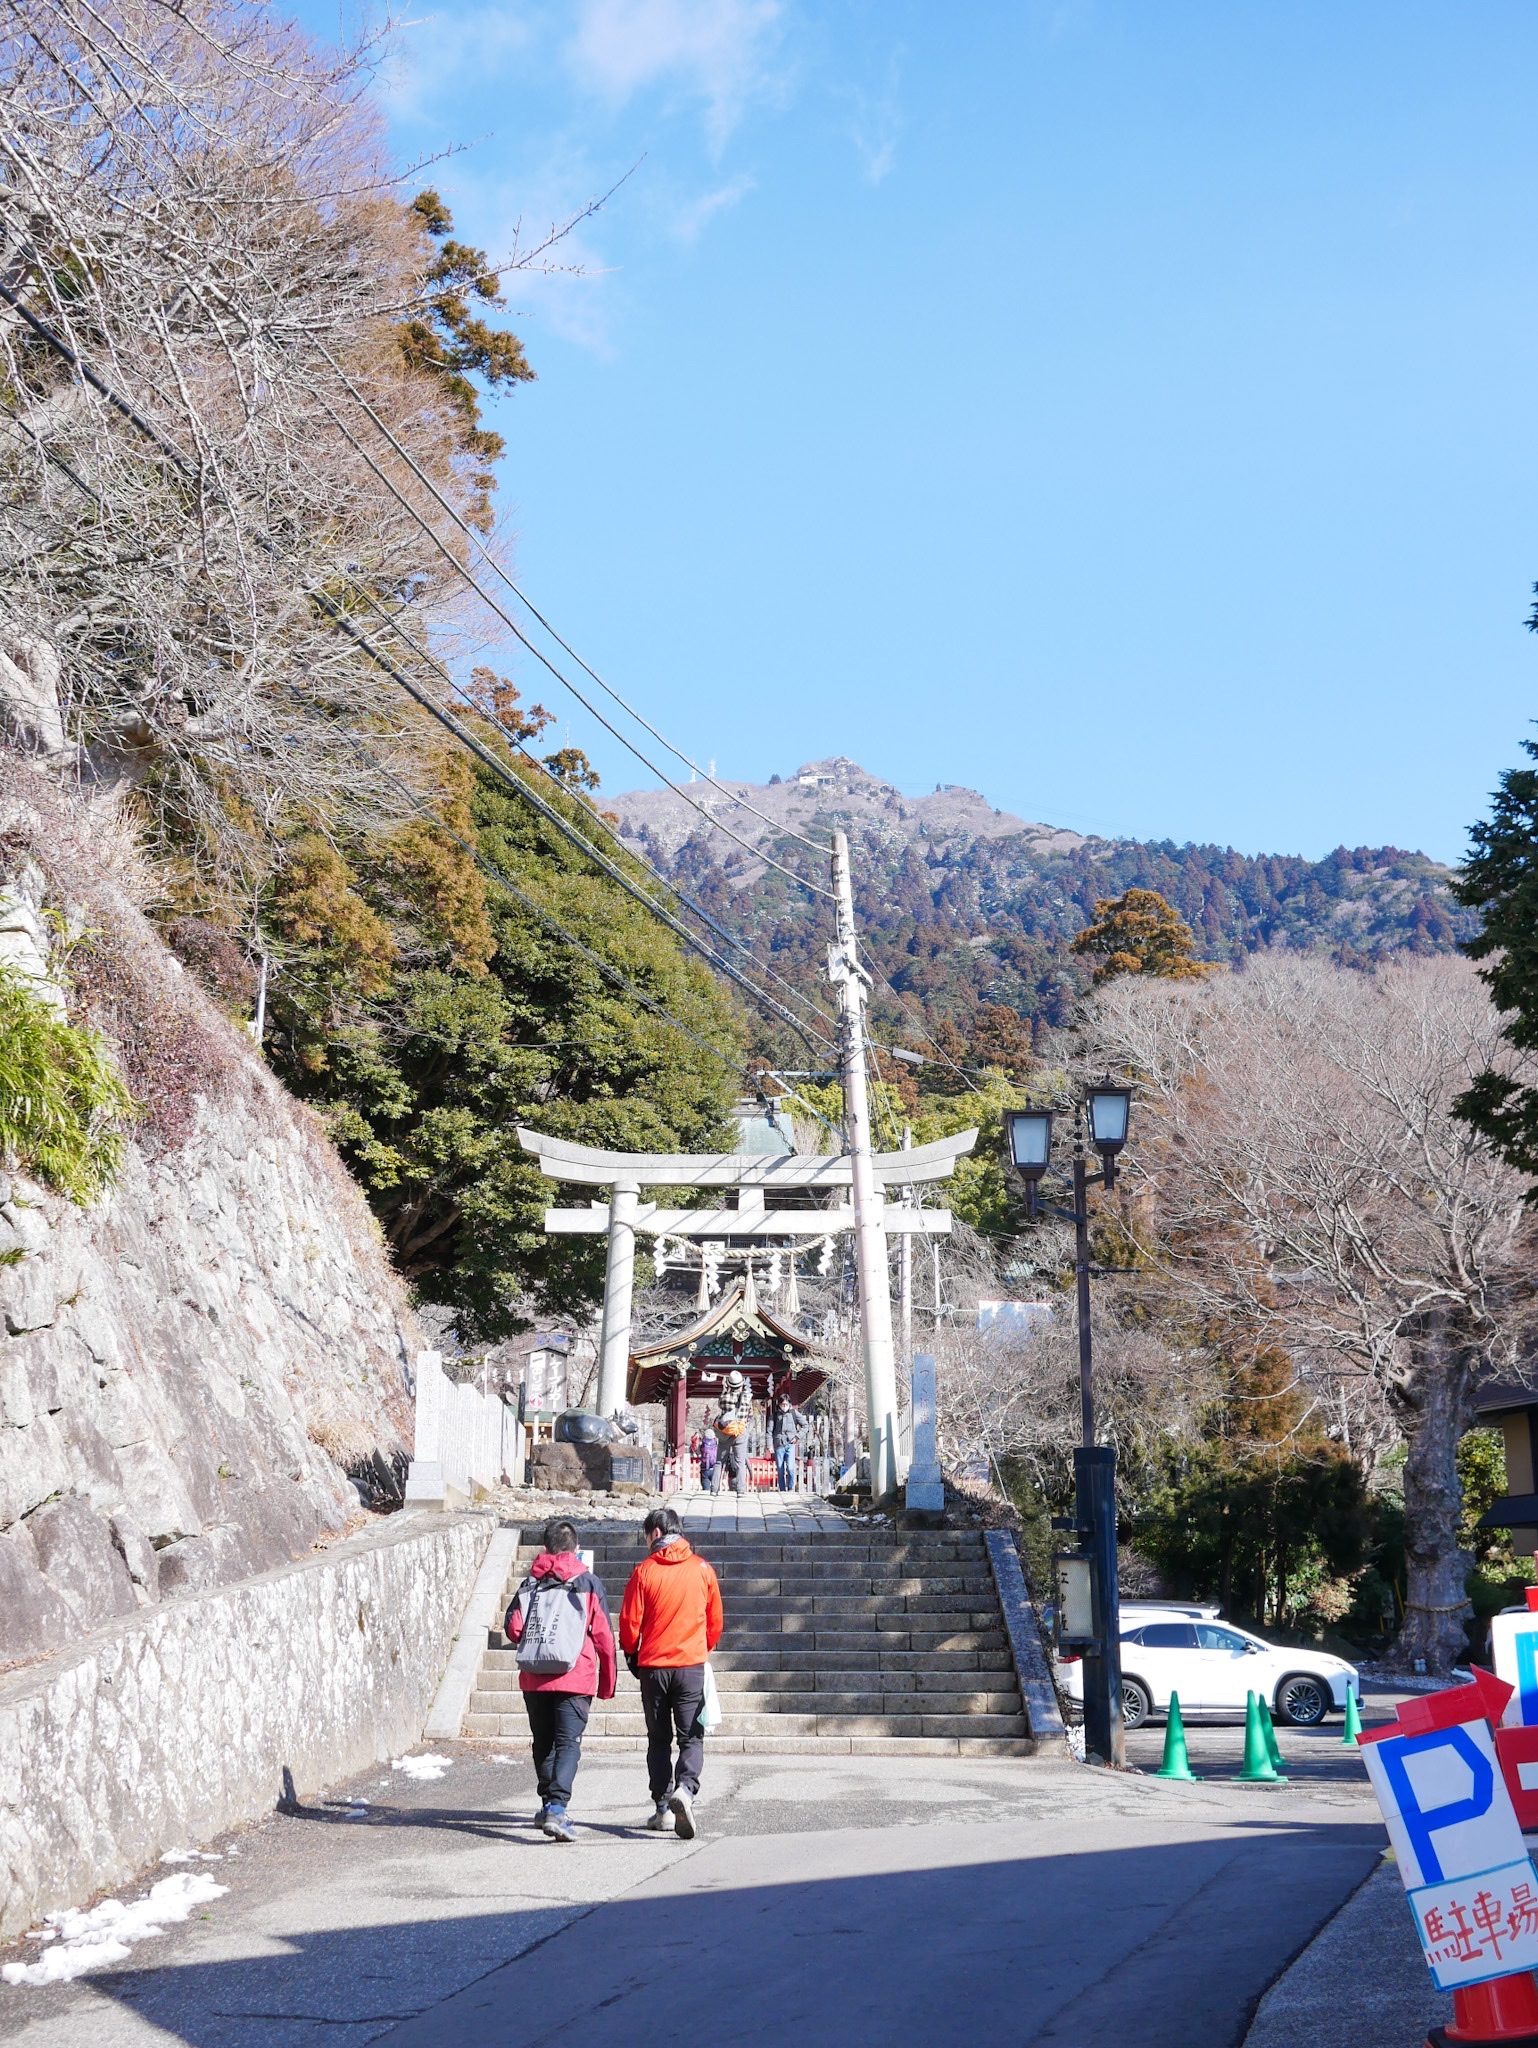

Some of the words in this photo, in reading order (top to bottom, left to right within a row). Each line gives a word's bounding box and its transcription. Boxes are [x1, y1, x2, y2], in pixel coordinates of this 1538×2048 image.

[526, 1595, 540, 1644] DEFENSE
[534, 1616, 543, 1644] SELF
[548, 1610, 559, 1644] JAPAN
[1377, 1725, 1493, 1884] P
[1424, 1883, 1538, 1965] 駐車場
